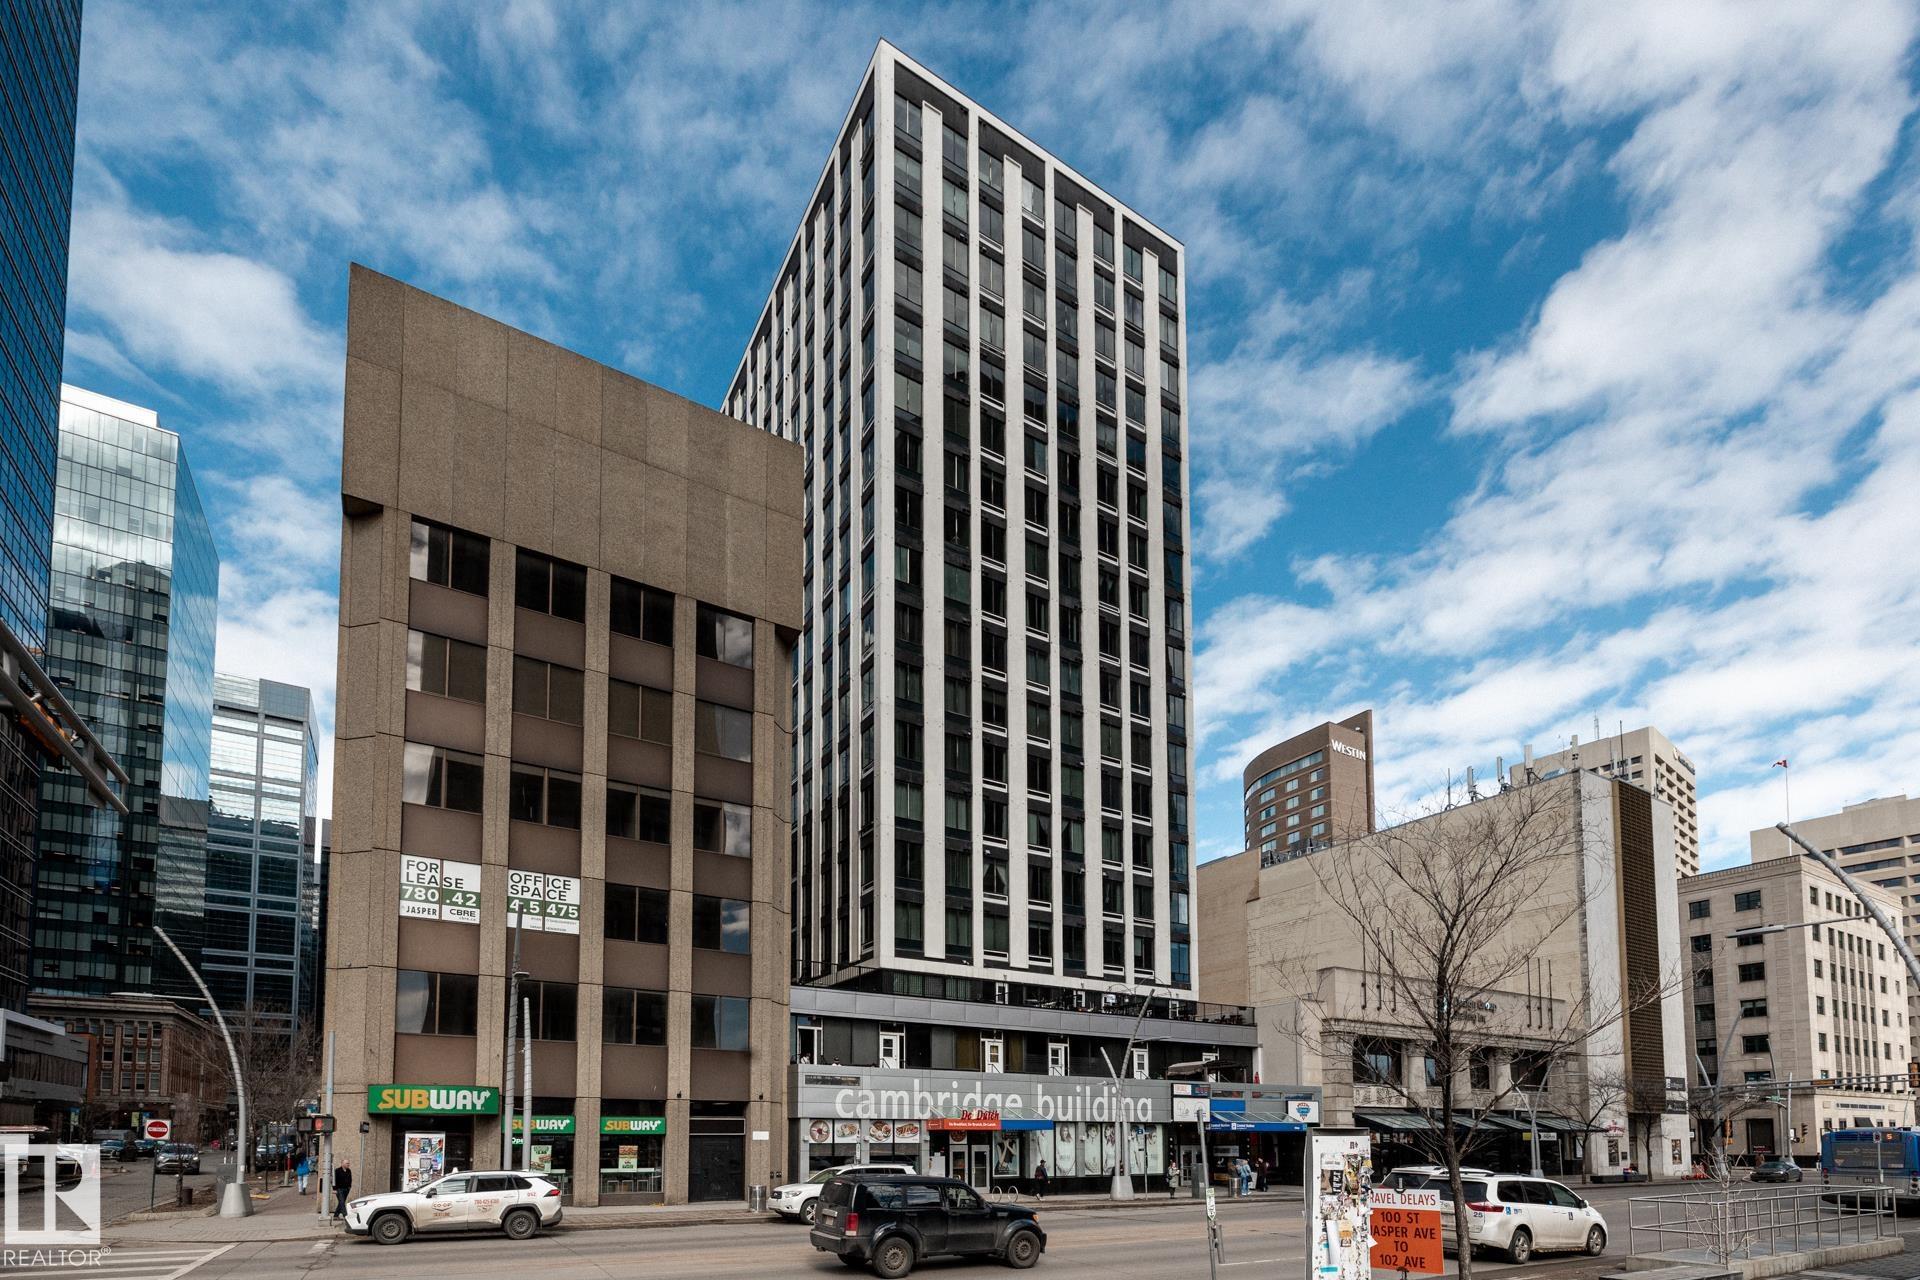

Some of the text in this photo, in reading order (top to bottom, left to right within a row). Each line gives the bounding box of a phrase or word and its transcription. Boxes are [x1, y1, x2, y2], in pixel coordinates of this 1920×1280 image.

[1331, 739, 1366, 761] WESTIN
[406, 859, 440, 874] FOR
[406, 871, 465, 890] LEASE
[509, 872, 572, 891] OFFICE
[509, 884, 567, 902] SPACE
[406, 905, 438, 917] JASPER
[449, 908, 477, 918] CBRE
[377, 1088, 492, 1111] SUBWAY
[604, 1119, 662, 1131] SUBWAY
[1370, 1193, 1436, 1206] RAVEL DELAYS
[1380, 1211, 1420, 1224] 100 ST
[1414, 1226, 1436, 1240] AVE
[1394, 1240, 1409, 1253] TO
[1379, 1254, 1426, 1269] 102 AVE
